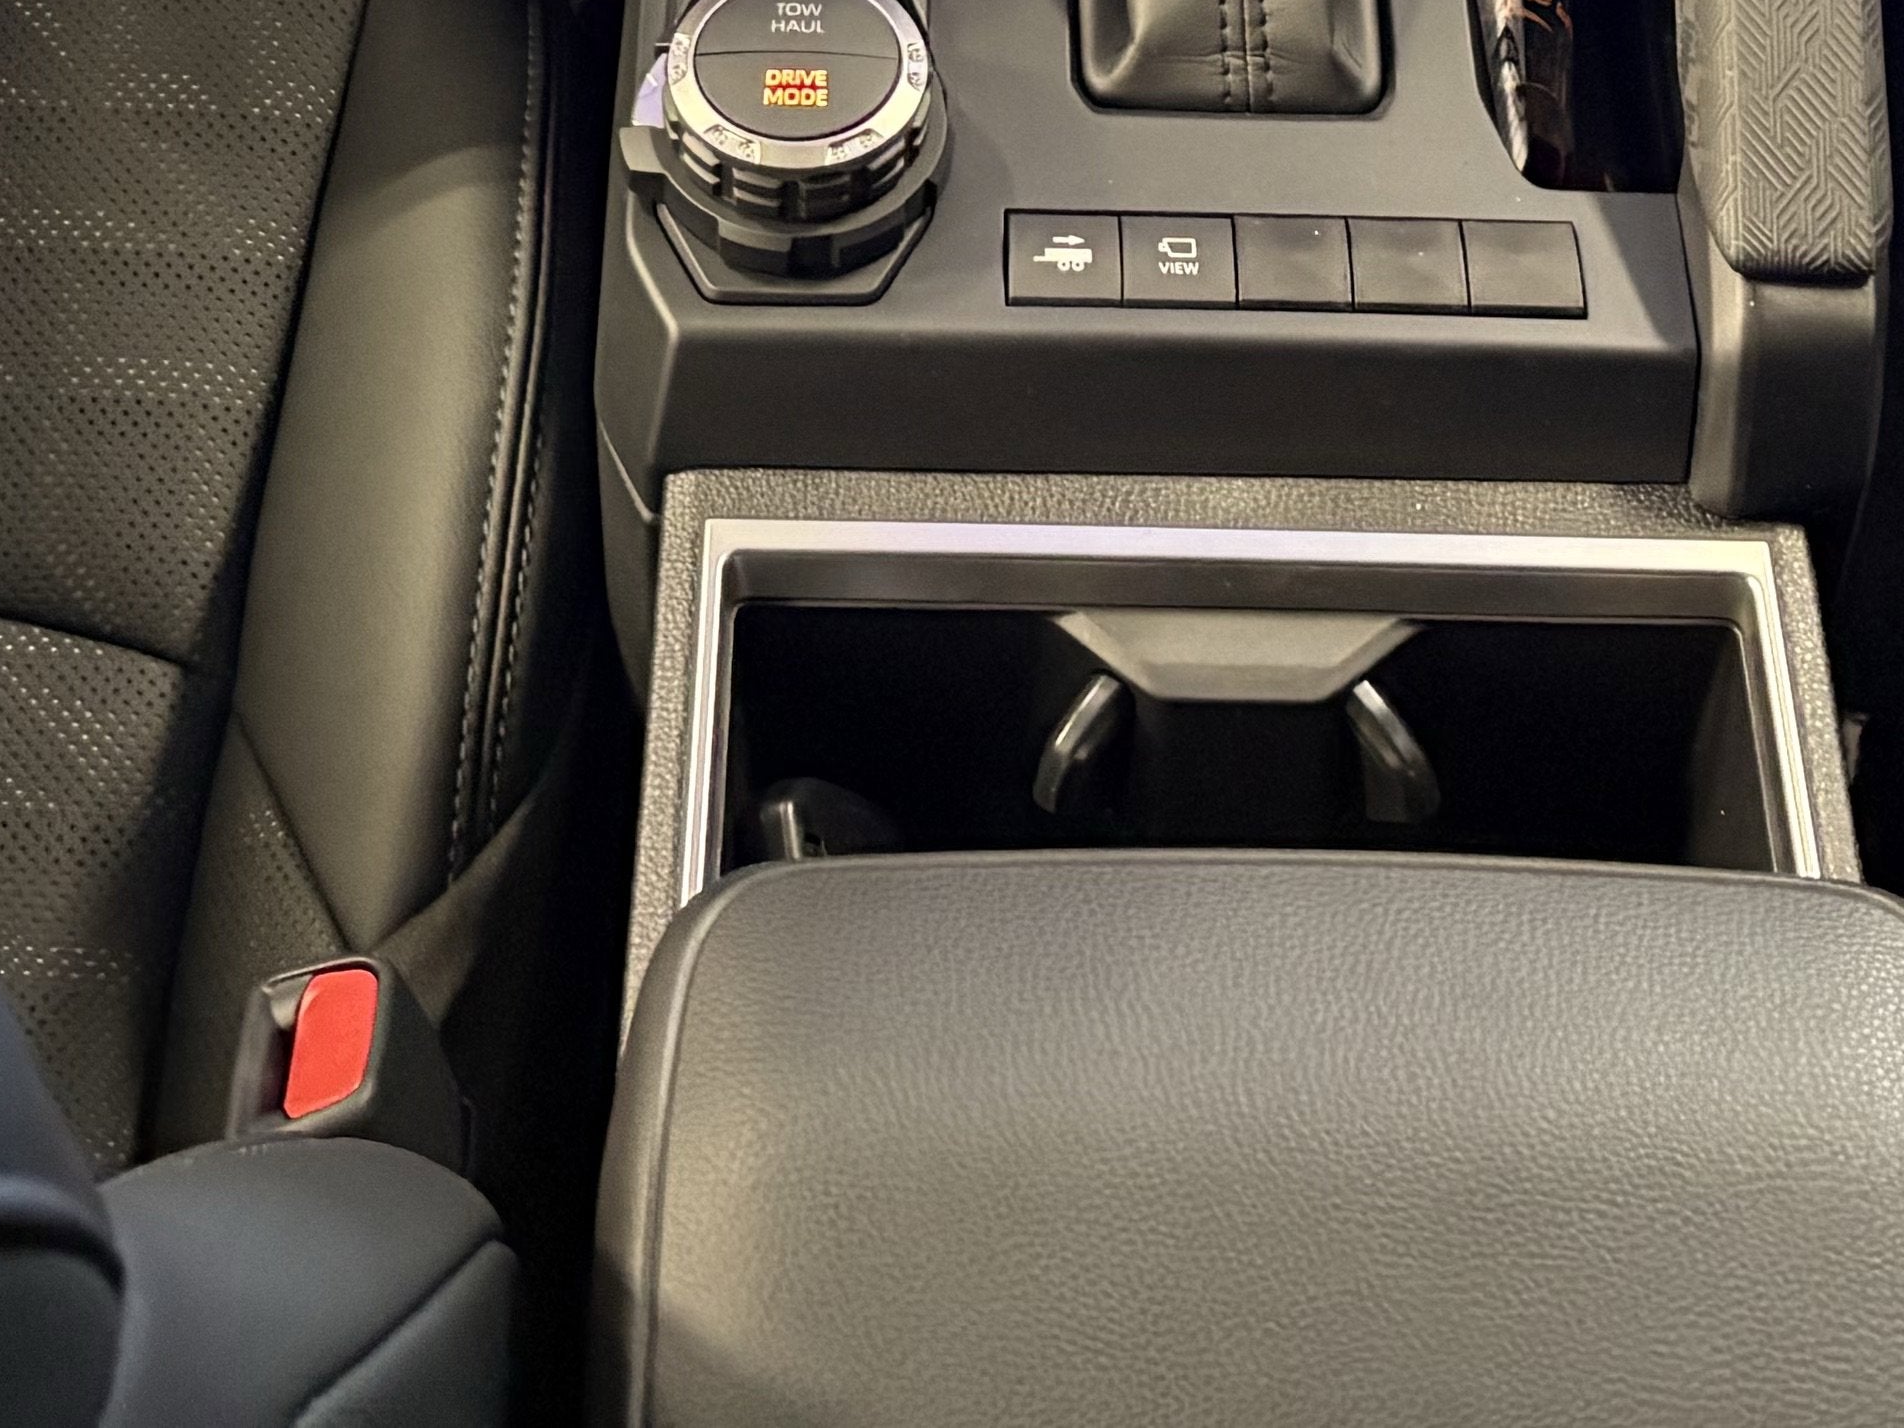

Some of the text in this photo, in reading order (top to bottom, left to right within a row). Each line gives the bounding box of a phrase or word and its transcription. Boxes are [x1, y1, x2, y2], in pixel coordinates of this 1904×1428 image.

[777, 3, 822, 17] TOW
[771, 19, 825, 35] HAUL
[764, 68, 828, 87] DRIVE
[763, 88, 828, 108] MODE
[1158, 261, 1199, 276] VIEW
